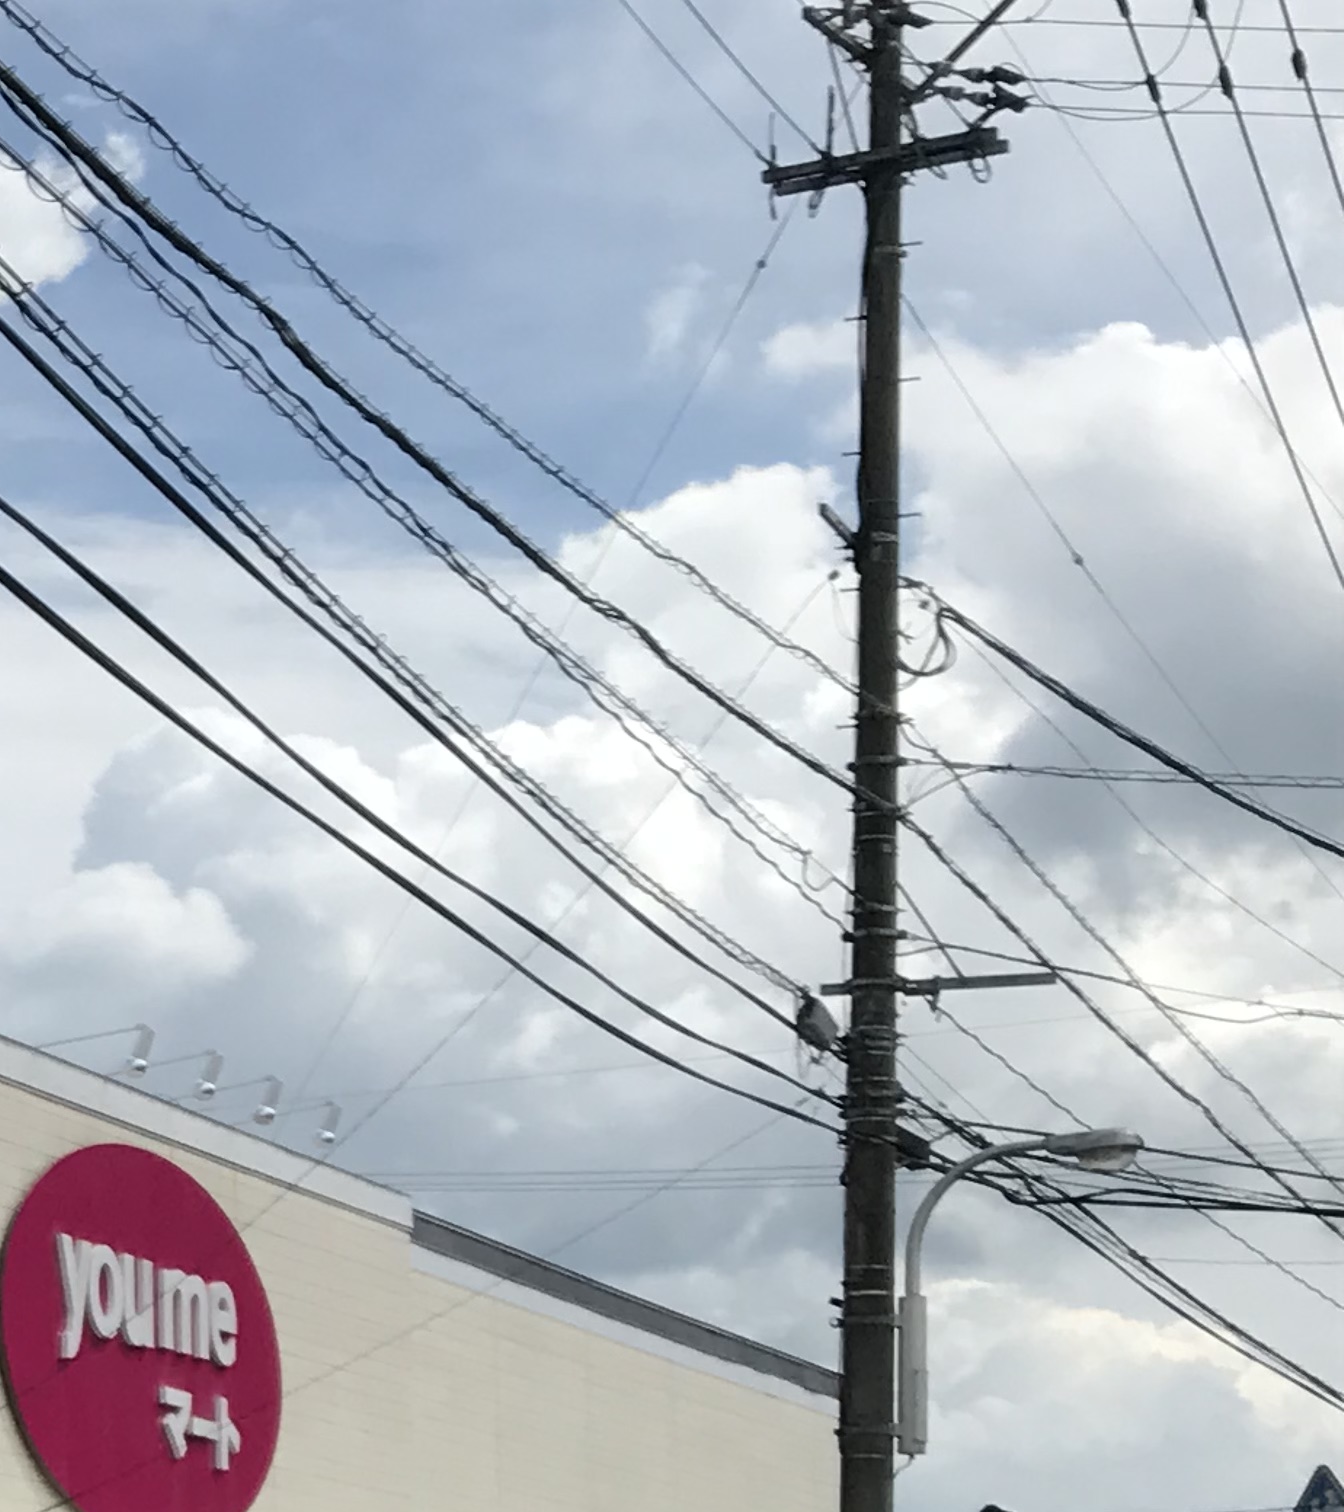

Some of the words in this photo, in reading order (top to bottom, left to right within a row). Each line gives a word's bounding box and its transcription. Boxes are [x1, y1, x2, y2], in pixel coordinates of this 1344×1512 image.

[56, 1231, 238, 1368] youme
[158, 1384, 242, 1472] マート
